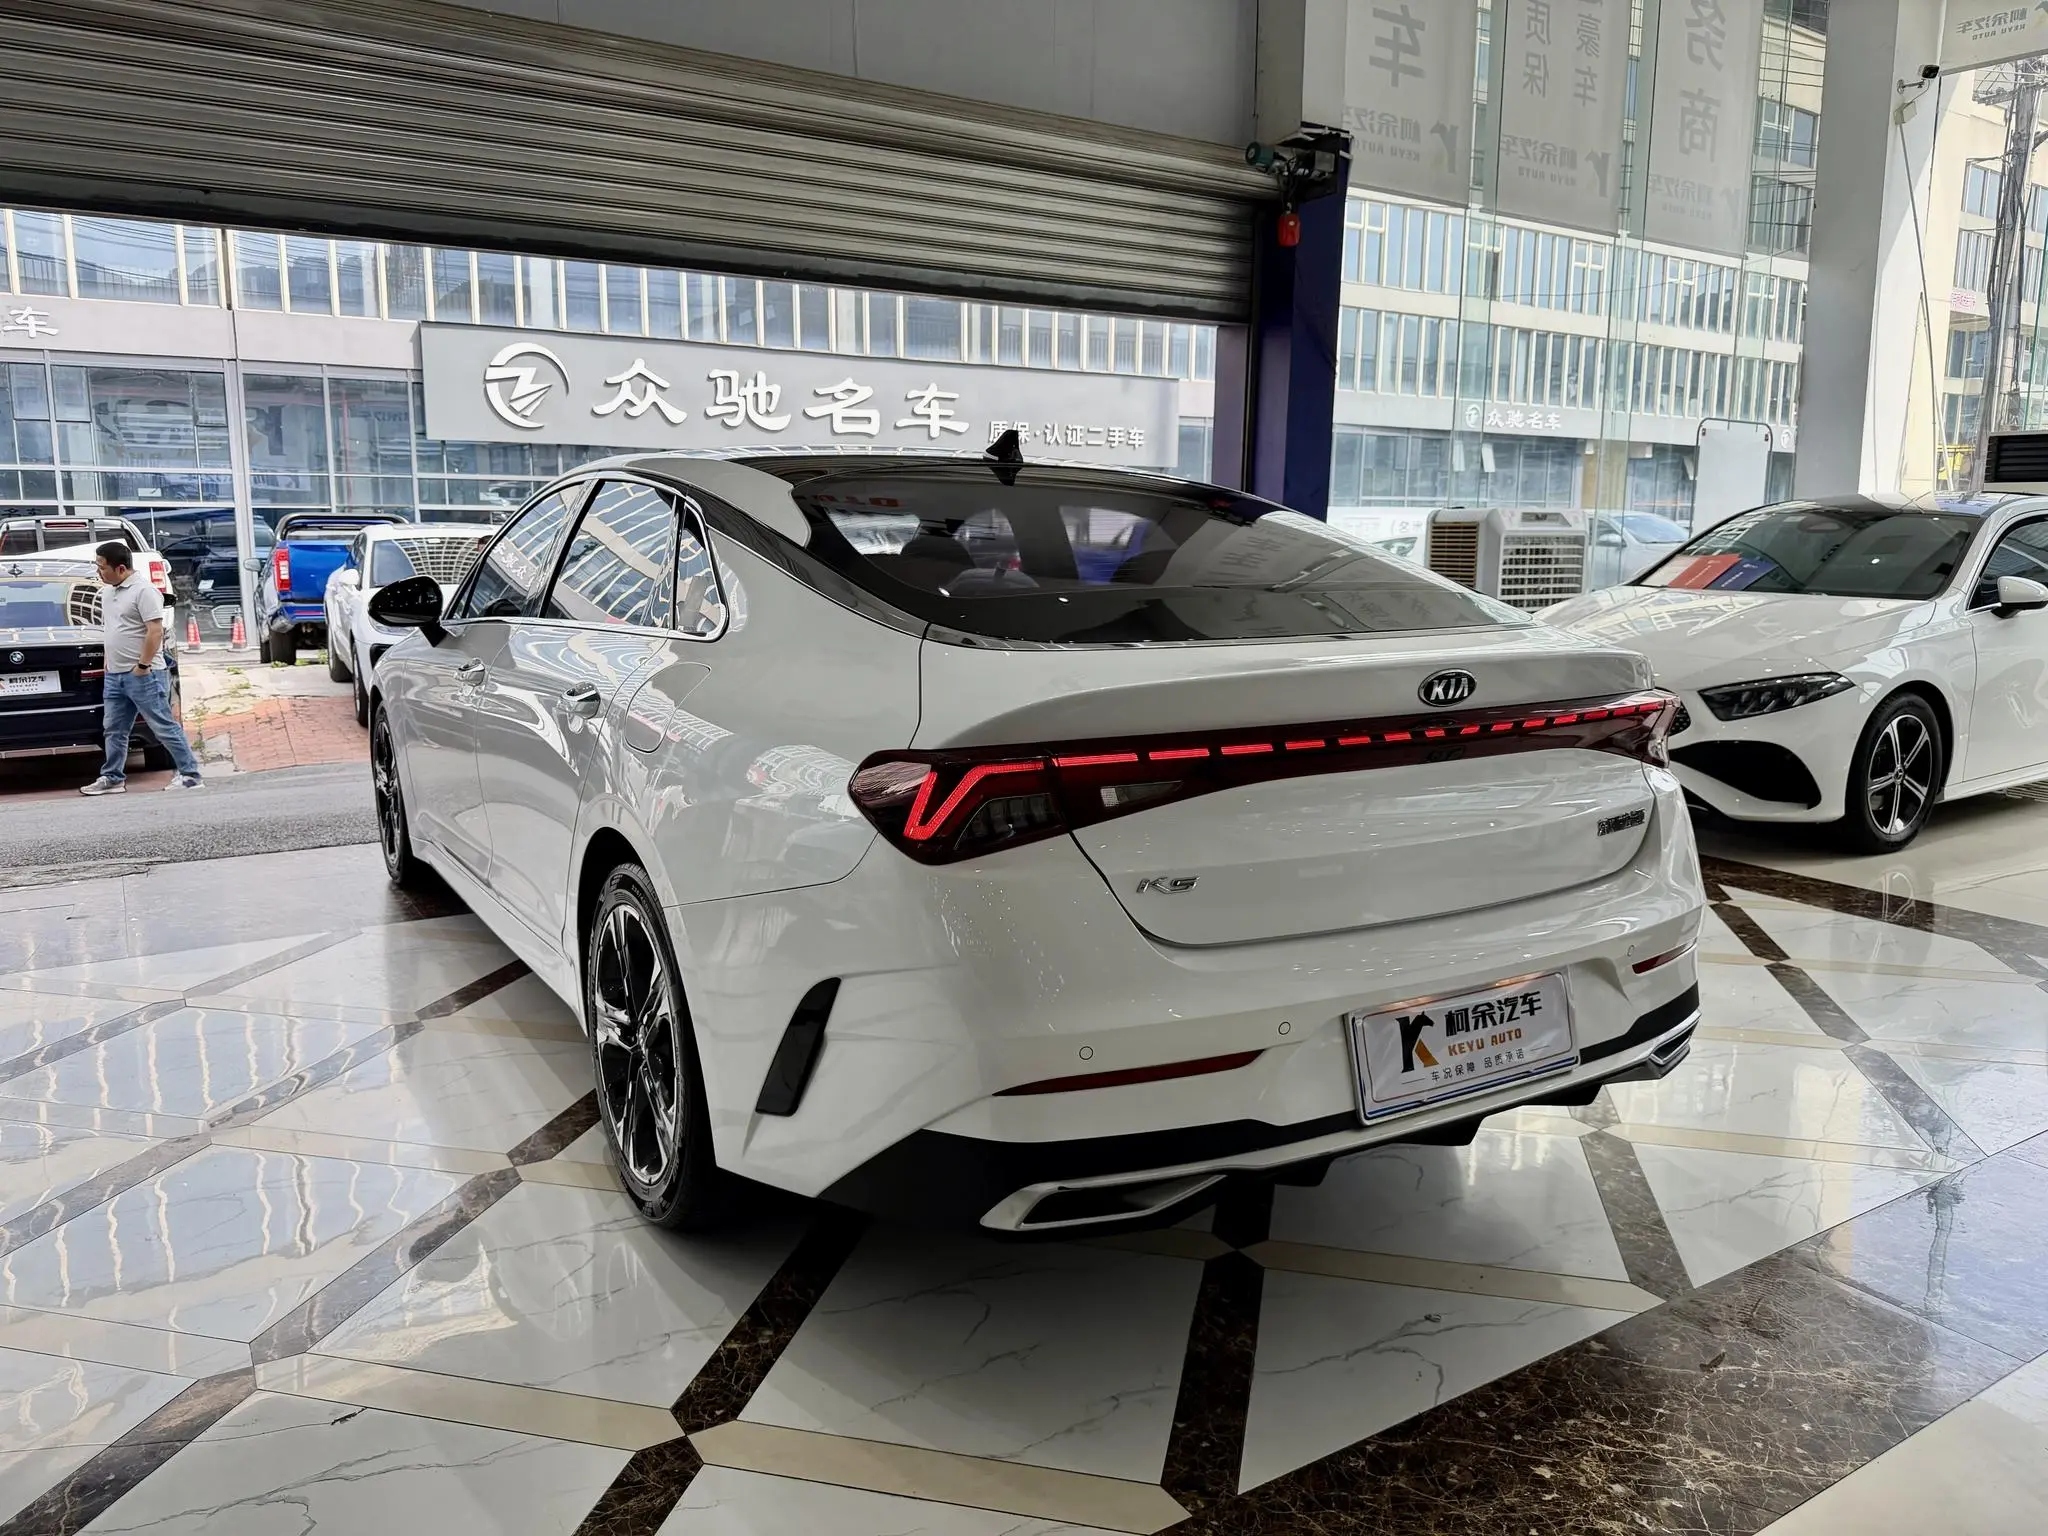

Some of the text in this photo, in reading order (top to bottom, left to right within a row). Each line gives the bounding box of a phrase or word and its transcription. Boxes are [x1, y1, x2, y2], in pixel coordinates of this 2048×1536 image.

[592, 358, 970, 438] 众驰名车
[1430, 677, 1469, 701] KIA
[1444, 990, 1543, 1037] 柯余汽车
[1447, 1028, 1522, 1057] KEYU AUTO
[1431, 1061, 1476, 1081] 车况保障
